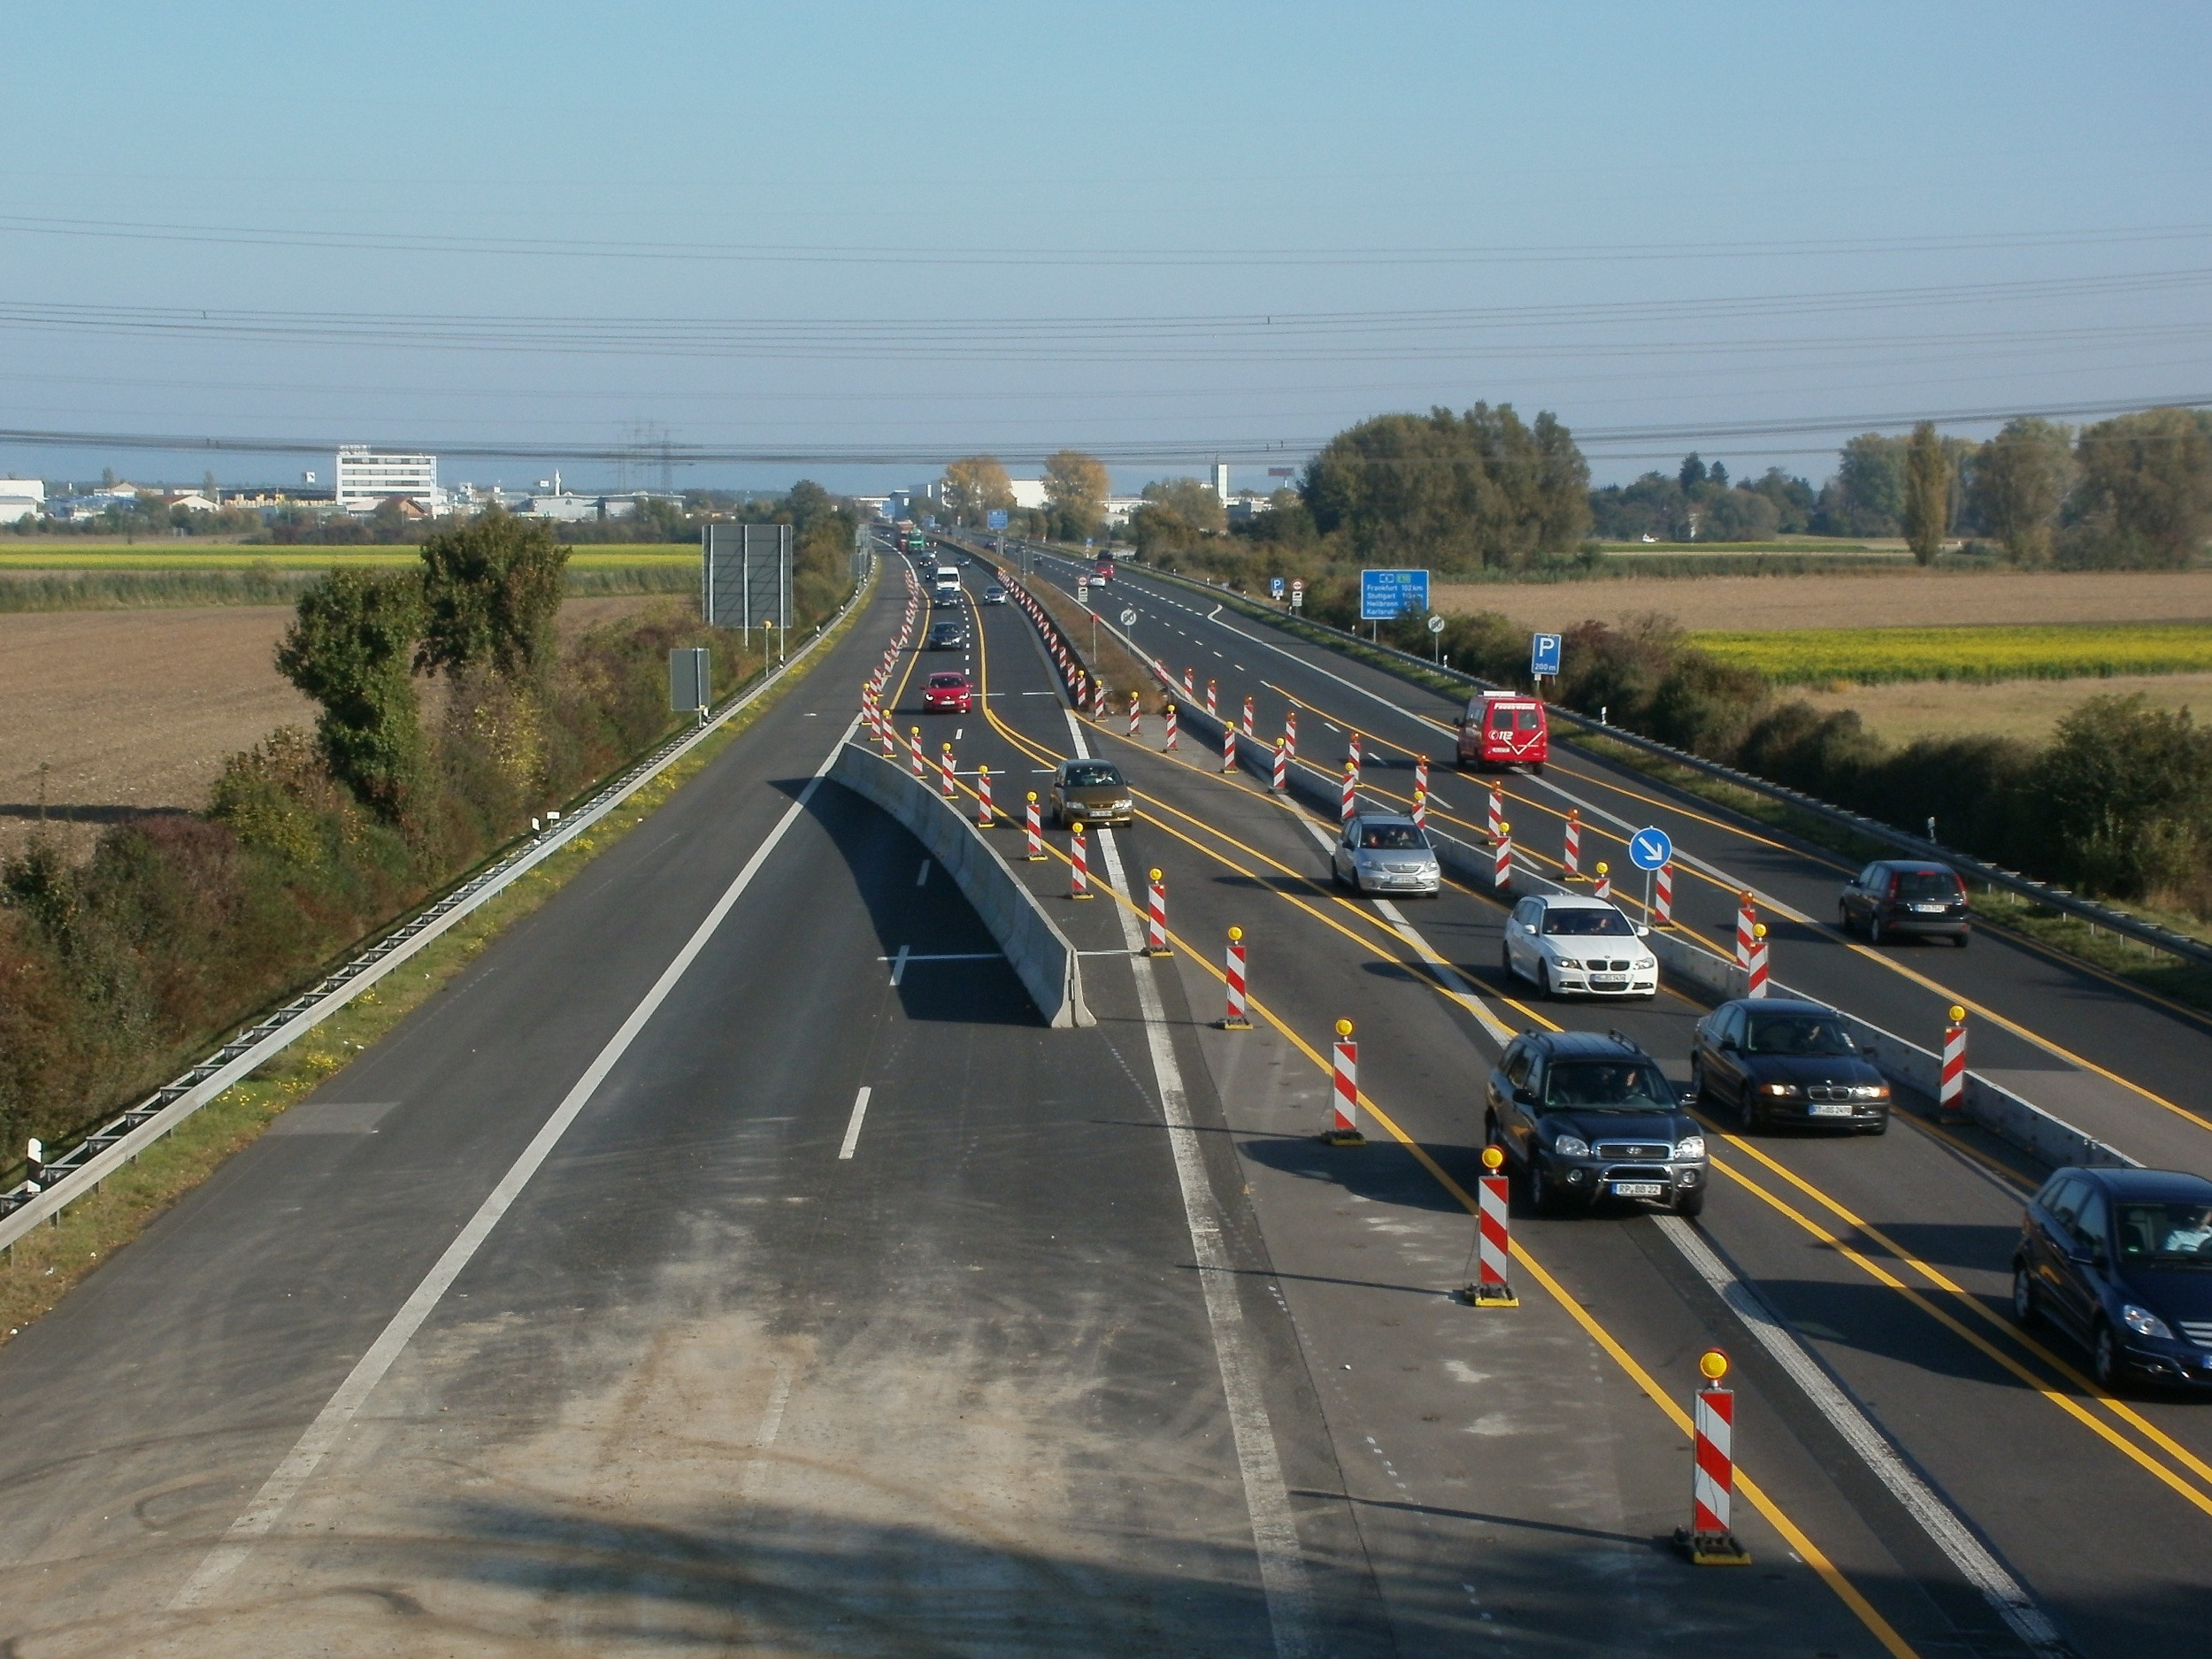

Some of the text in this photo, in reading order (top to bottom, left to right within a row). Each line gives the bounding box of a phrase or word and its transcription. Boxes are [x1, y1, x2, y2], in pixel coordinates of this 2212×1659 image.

[1274, 580, 1281, 588] P
[1539, 637, 1555, 657] P
[1499, 731, 1514, 741] 112
